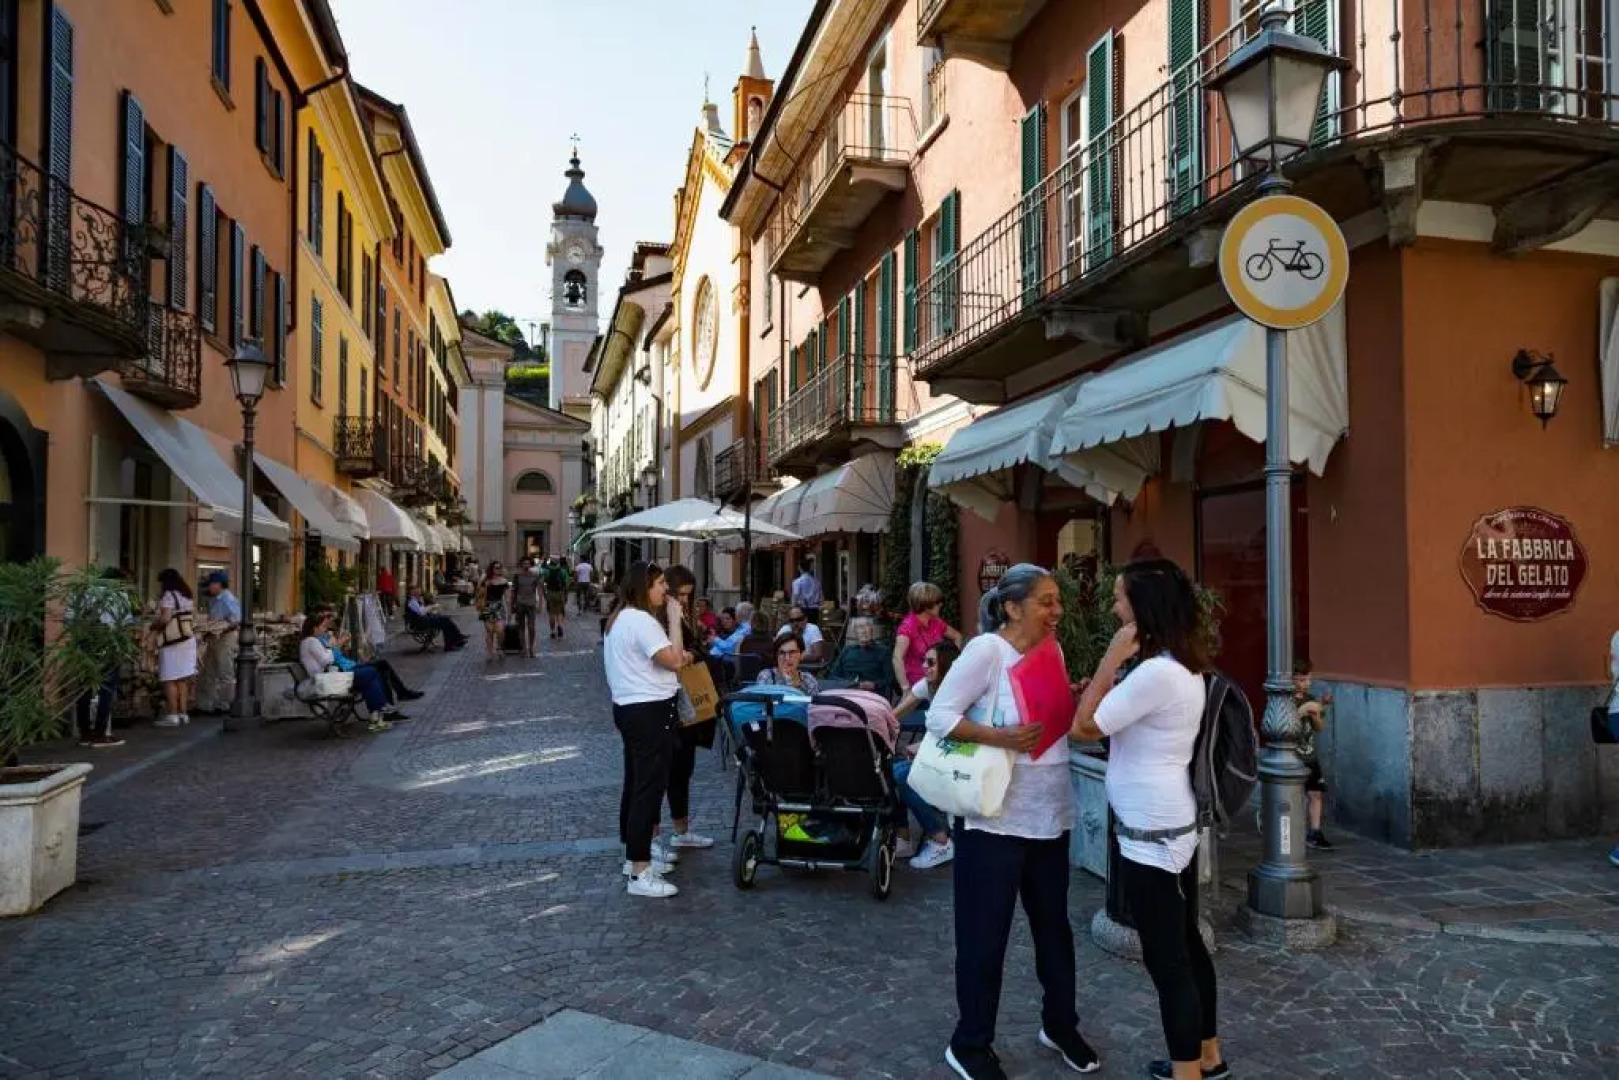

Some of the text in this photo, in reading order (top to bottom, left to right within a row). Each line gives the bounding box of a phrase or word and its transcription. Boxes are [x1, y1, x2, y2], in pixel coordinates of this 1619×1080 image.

[1477, 537, 1575, 561] LA FABBRICA
[1486, 564, 1569, 586] DEL GELATO
